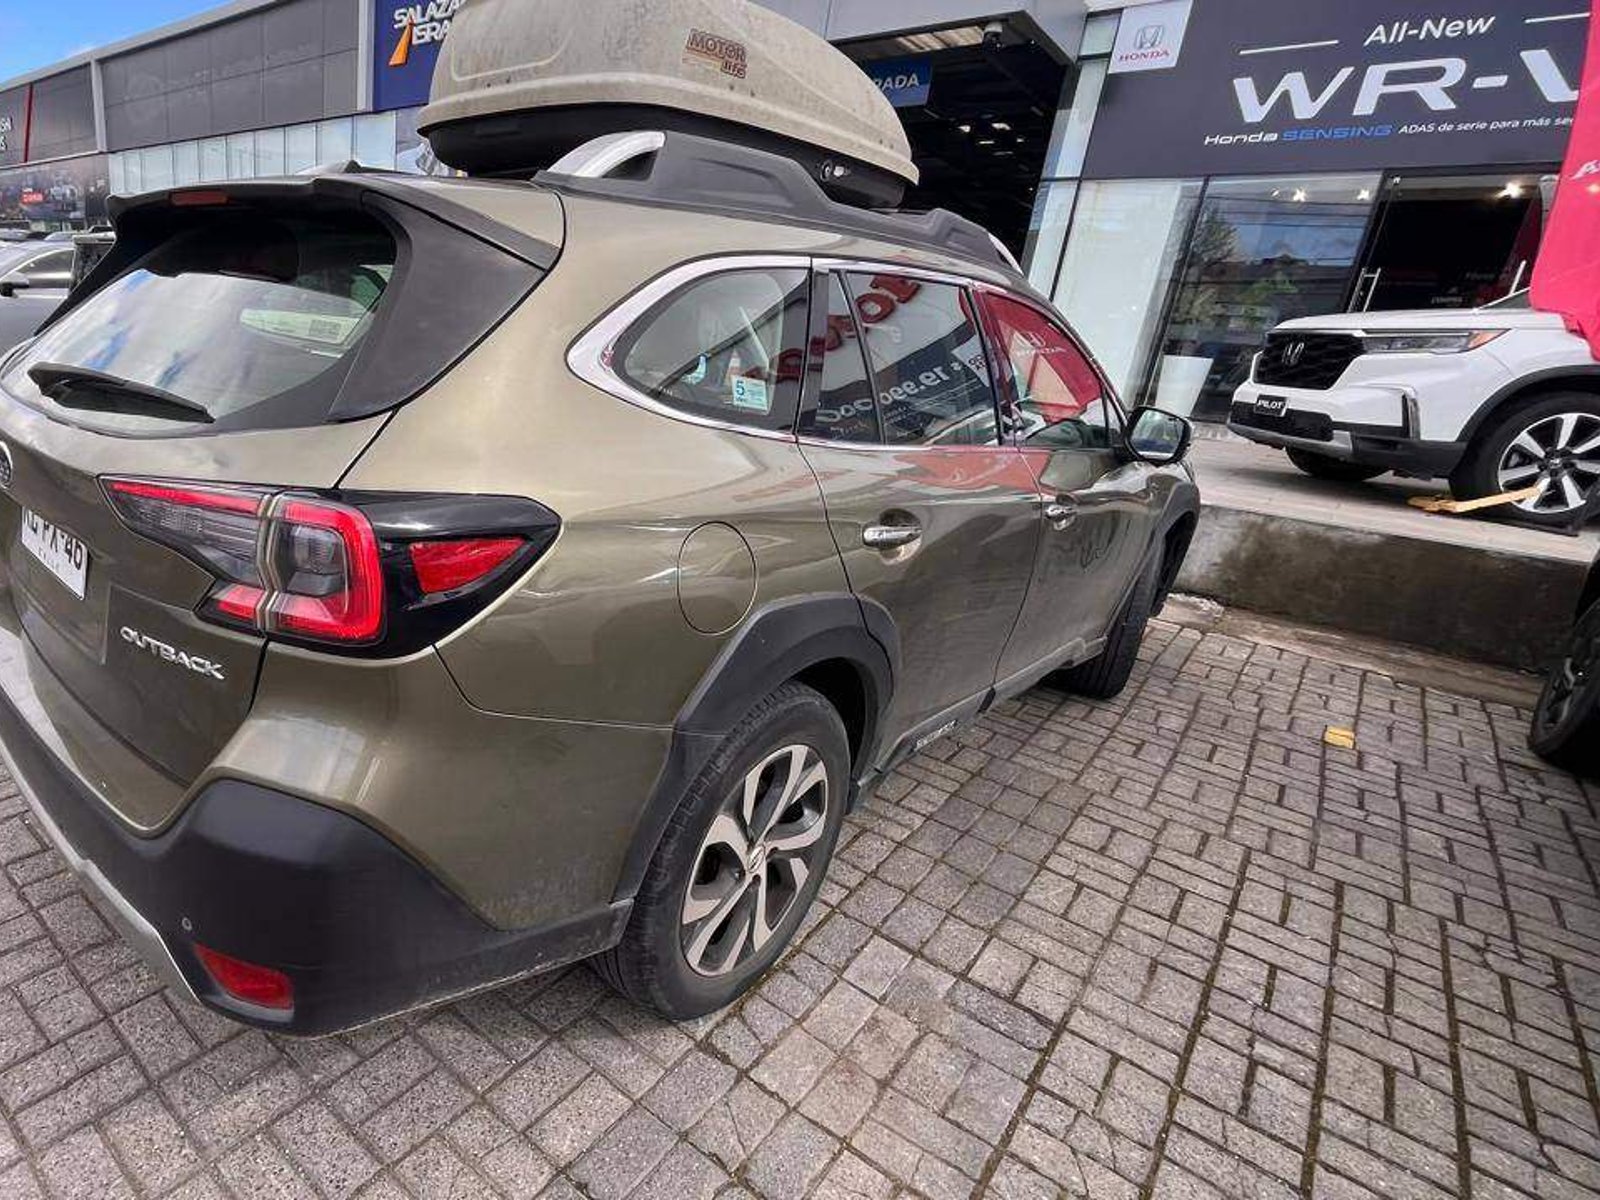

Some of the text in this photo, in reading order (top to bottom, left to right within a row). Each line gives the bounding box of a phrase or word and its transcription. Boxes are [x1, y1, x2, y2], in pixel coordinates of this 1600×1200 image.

[394, 0, 467, 29] SALAZA
[1364, 16, 1496, 47] All-New
[1119, 49, 1170, 62] HONDA
[1204, 131, 1279, 146] Honda
[1282, 124, 1394, 142] SENSING
[1399, 122, 1436, 135] ADAS
[1438, 121, 1454, 132] de
[1456, 120, 1487, 132] serie
[1490, 119, 1520, 131] para
[1523, 116, 1551, 128] más
[736, 380, 745, 396] 5
[120, 626, 225, 680] OUTBACK
